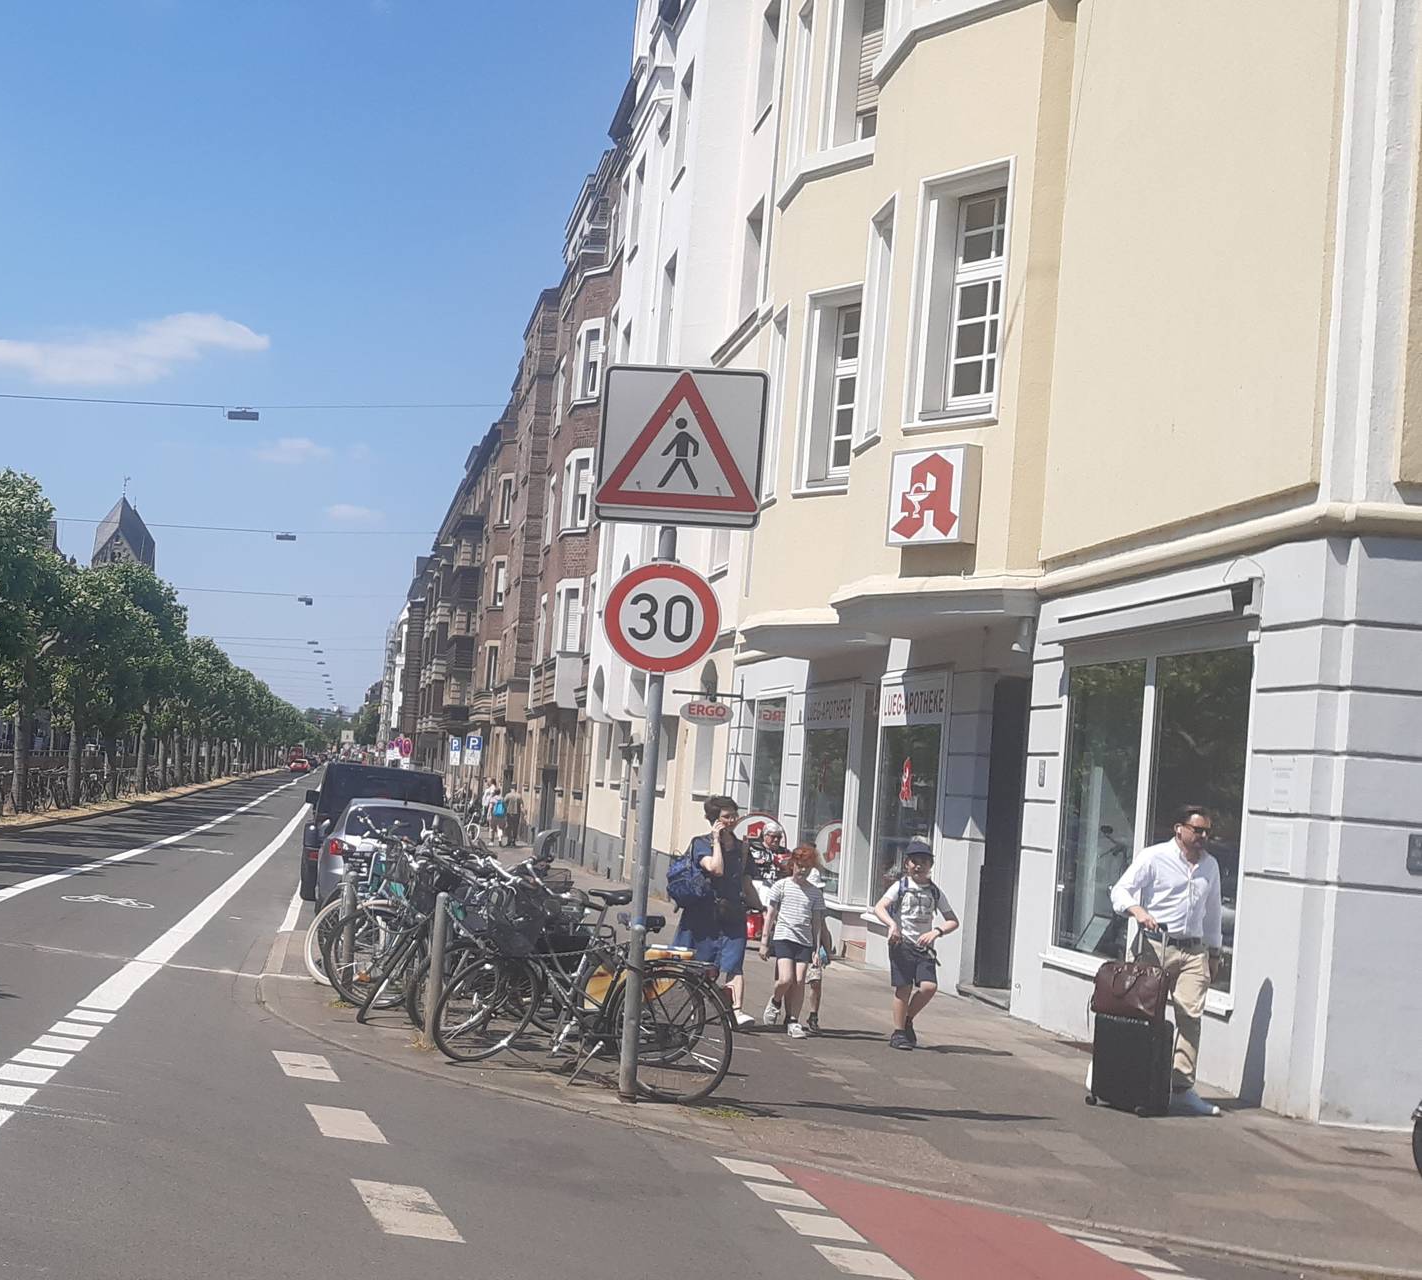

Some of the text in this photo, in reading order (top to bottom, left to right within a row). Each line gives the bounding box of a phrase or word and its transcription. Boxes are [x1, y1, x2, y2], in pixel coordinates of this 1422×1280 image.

[628, 593, 694, 643] 30
[688, 704, 726, 717] ERGO
[884, 689, 945, 716] LUEG-APOTHEKE
[469, 737, 479, 749] P
